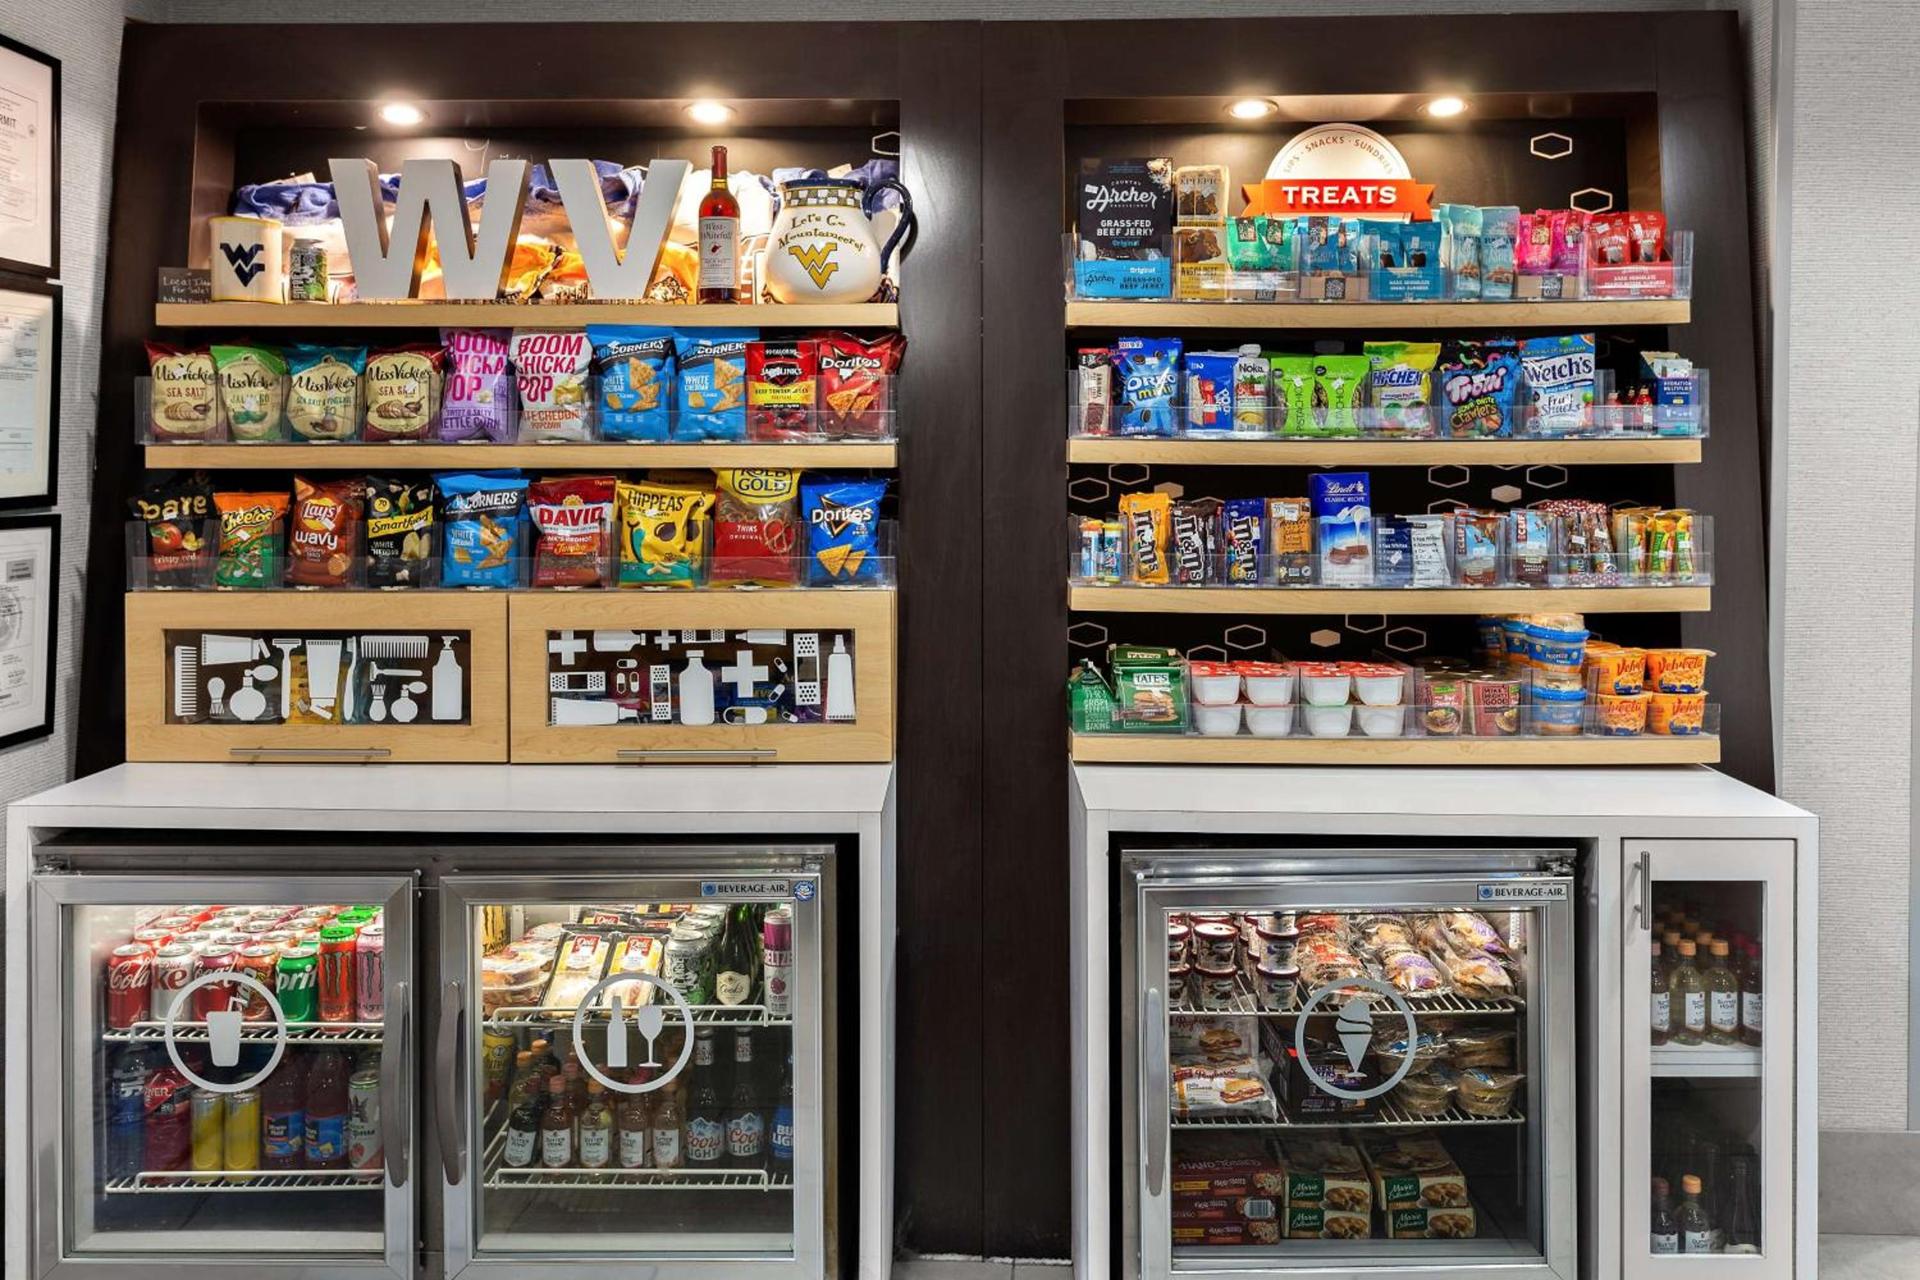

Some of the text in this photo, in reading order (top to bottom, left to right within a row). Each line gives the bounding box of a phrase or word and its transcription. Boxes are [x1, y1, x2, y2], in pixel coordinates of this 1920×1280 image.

[1305, 136, 1345, 152] SNACKS
[1354, 139, 1393, 175] SUNDRIES
[1085, 184, 1158, 212] Archer
[1281, 186, 1398, 205] TREATS
[791, 213, 822, 230] Let's
[1101, 219, 1151, 227] GRASS-FED
[1097, 228, 1154, 236] BEEF JERKY
[518, 334, 584, 356] BOOM
[514, 356, 577, 375] CHICKA
[821, 356, 881, 370] Doritos
[1523, 355, 1593, 383] Welch's
[292, 375, 324, 392] Miss
[369, 367, 394, 382] Miss
[684, 375, 709, 385] WHITE
[1126, 373, 1177, 391] OREO
[167, 387, 206, 398] SEA SALT
[379, 386, 394, 396] SEA
[516, 375, 555, 403] POP
[1294, 383, 1305, 432] PISTACHIO
[442, 417, 472, 430] ETTLE
[1450, 405, 1498, 429] Crawlers
[738, 478, 788, 492] GOLD
[1326, 481, 1354, 495] Lindt
[137, 494, 207, 520] bare
[627, 490, 686, 512] HIPPEAS
[220, 505, 276, 535] Cheetos
[372, 511, 431, 534] Smartfood
[539, 506, 605, 526] DAVID
[811, 507, 874, 524] Doritos
[1517, 512, 1526, 534] CLIF
[736, 524, 758, 533] THINS
[295, 530, 338, 550] wavy
[1135, 673, 1168, 683] TATE'S
[777, 1124, 793, 1135] BU
